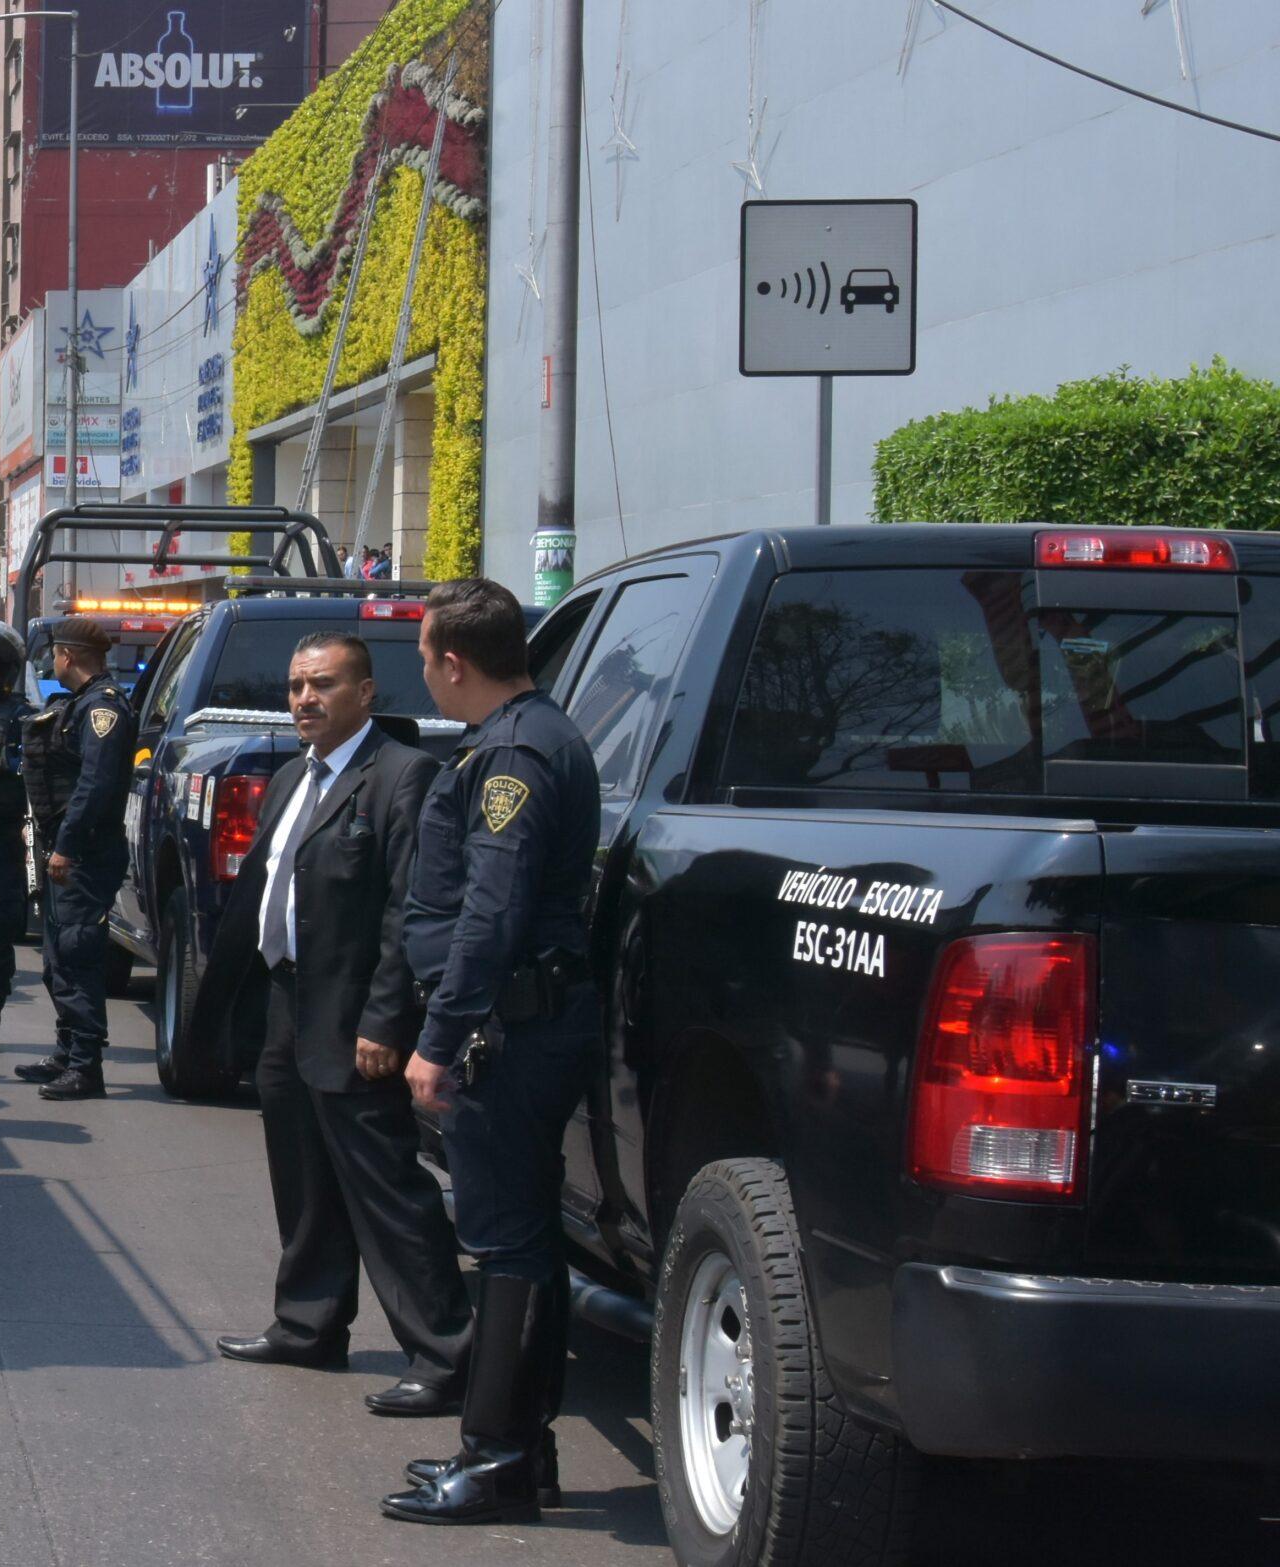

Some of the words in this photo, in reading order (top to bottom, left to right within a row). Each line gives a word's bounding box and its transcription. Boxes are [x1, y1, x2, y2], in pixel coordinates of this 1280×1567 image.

[56, 396, 111, 404] PAPORTES
[52, 477, 102, 486] bevides
[486, 780, 523, 796] POLICIA
[777, 865, 858, 910] VEHÍCULO
[859, 881, 944, 925] ESCOLTA
[793, 920, 885, 978] ESC-31AA
